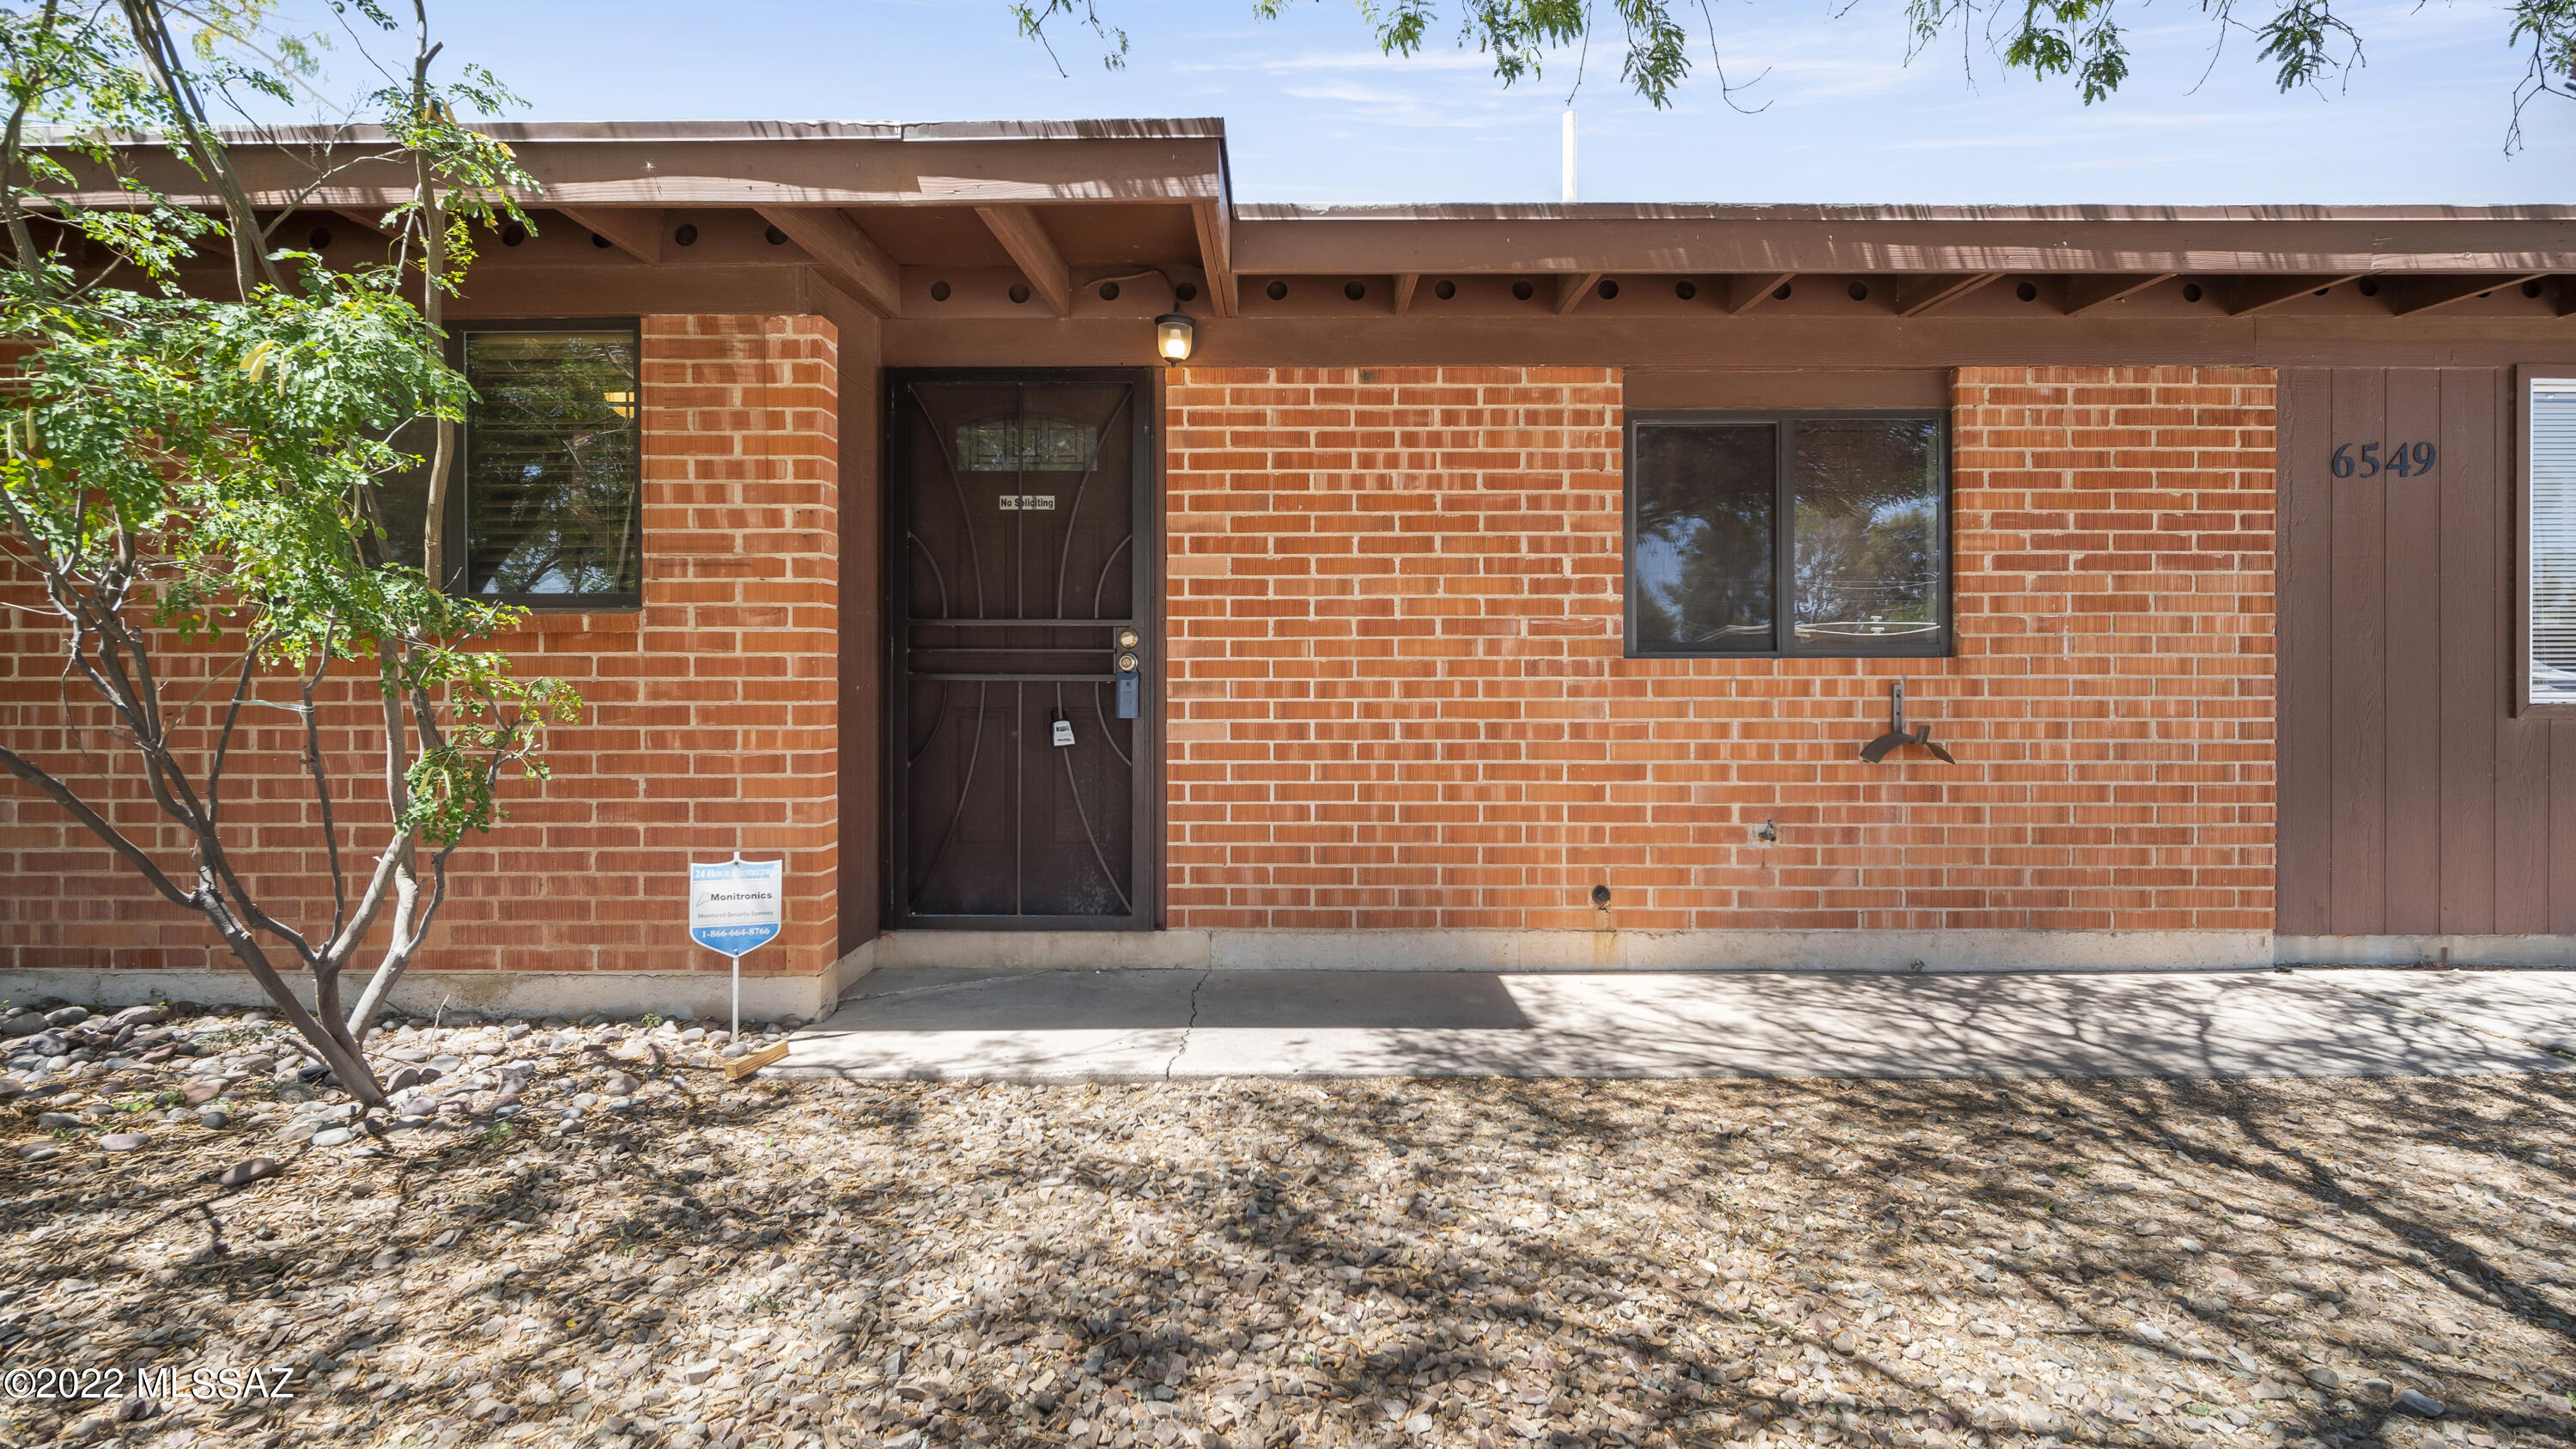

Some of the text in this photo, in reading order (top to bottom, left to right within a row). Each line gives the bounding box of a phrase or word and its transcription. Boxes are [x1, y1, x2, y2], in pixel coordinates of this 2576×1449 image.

[2332, 441, 2436, 478] 6549
[1000, 498, 1012, 507] No
[695, 869, 705, 879] 24
[710, 892, 772, 901] Monitronics
